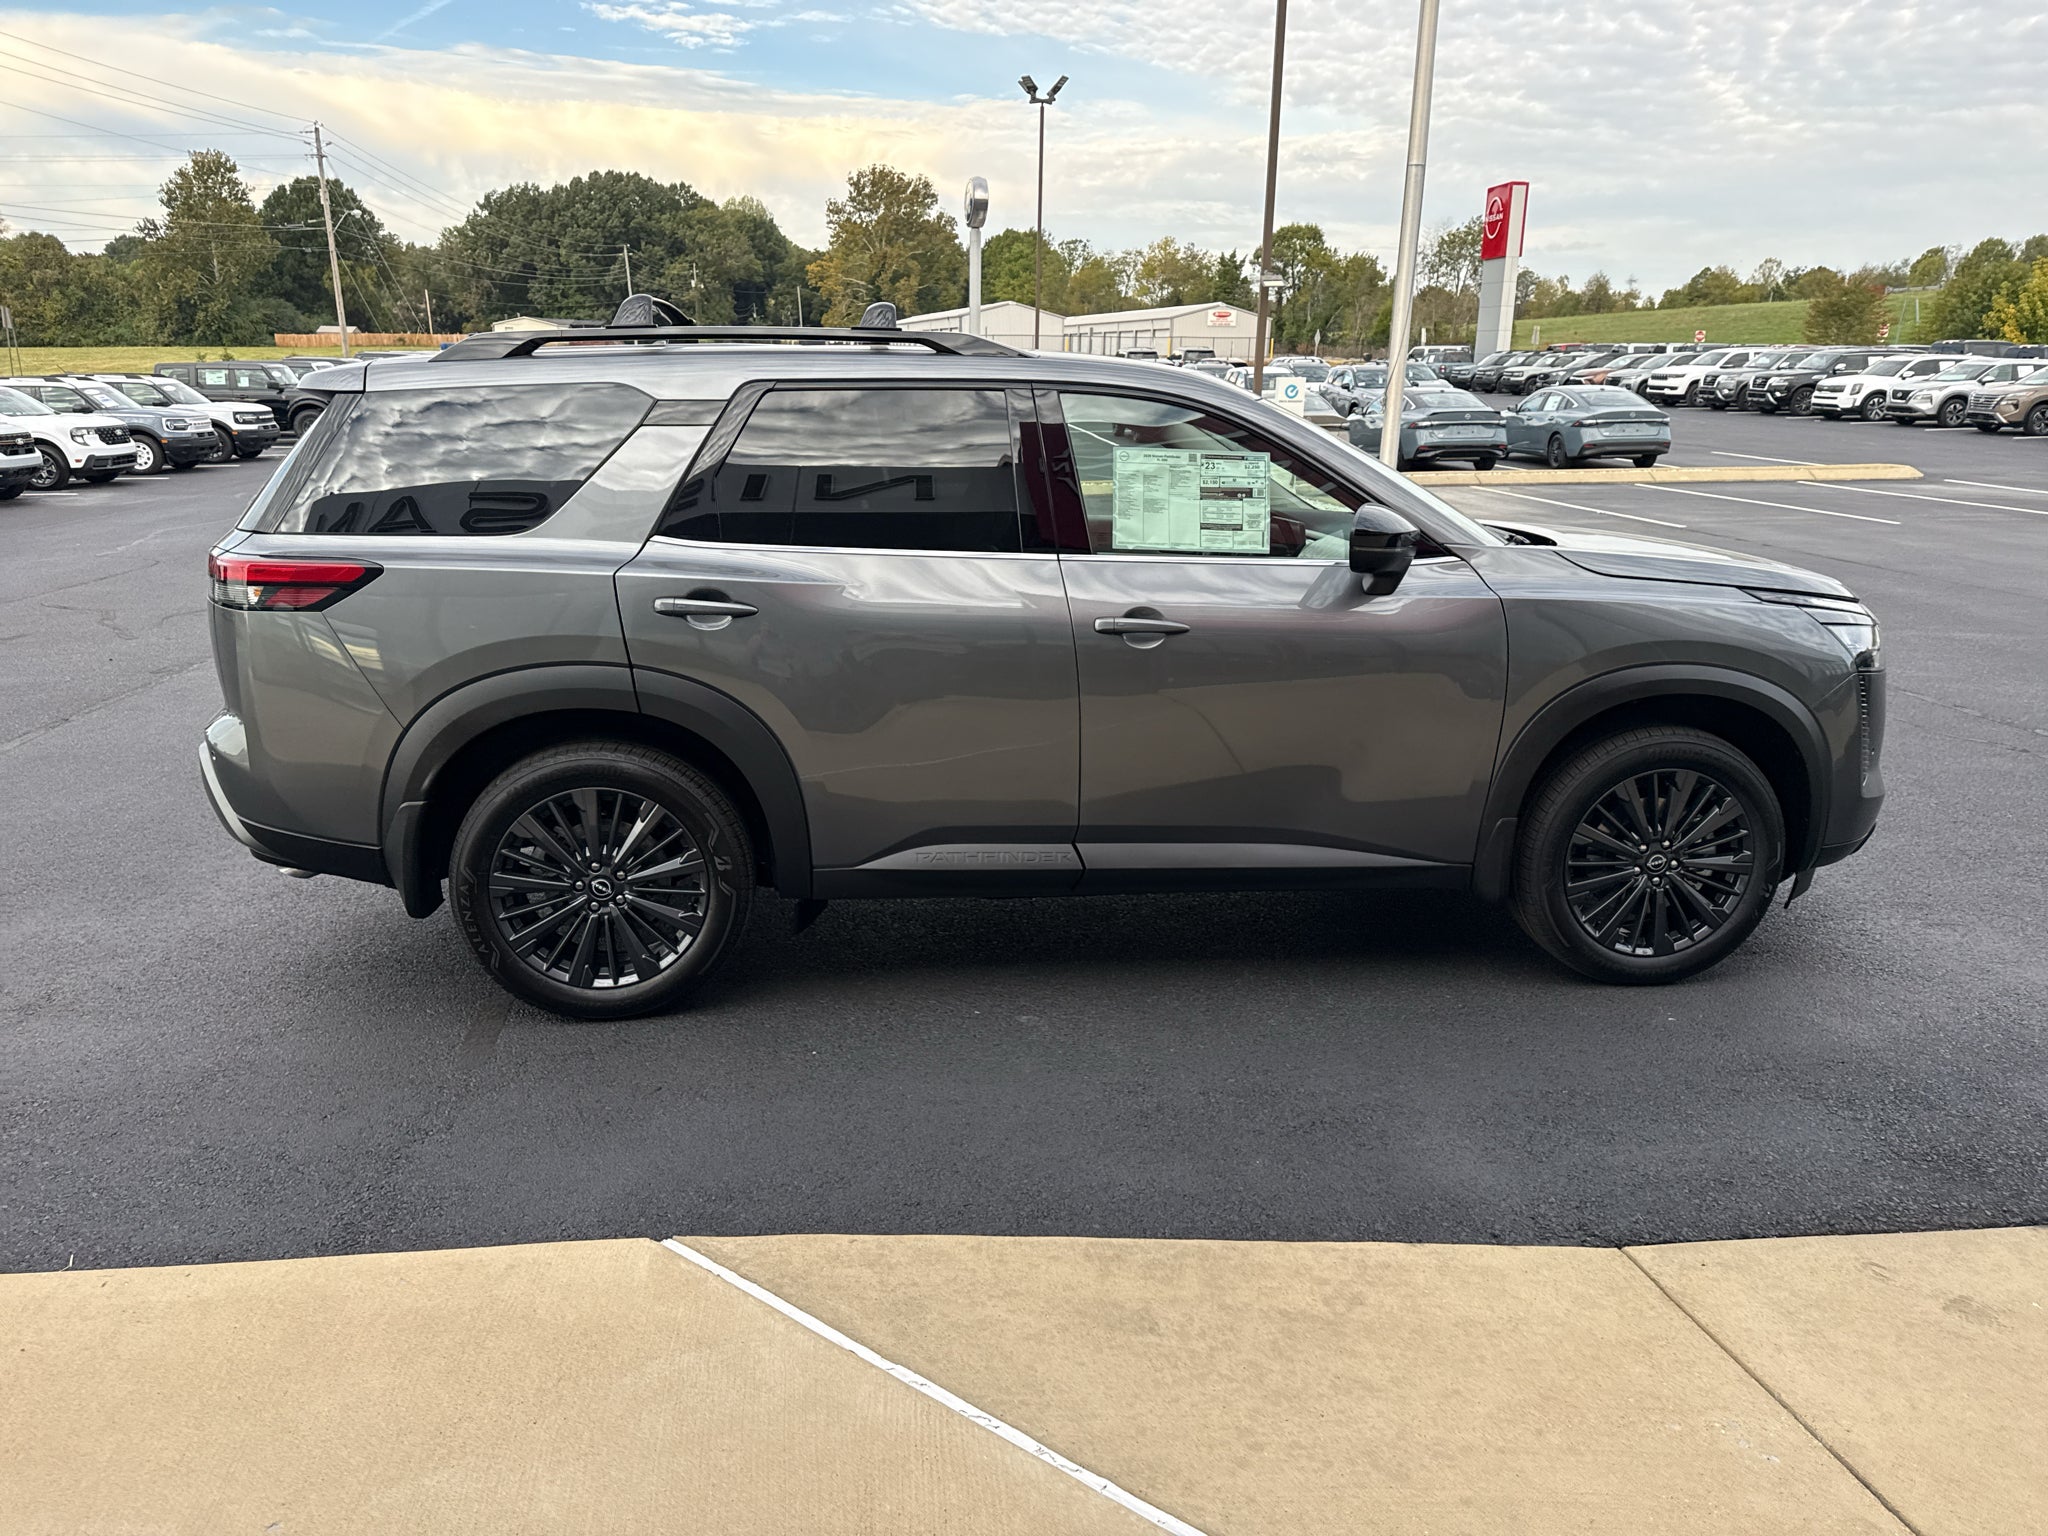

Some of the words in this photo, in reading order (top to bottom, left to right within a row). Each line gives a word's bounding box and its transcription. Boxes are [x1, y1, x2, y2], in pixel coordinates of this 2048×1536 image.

[1204, 461, 1216, 470] 23
[915, 851, 1073, 865] PATHFINDER
[458, 884, 489, 953] ALENZA
